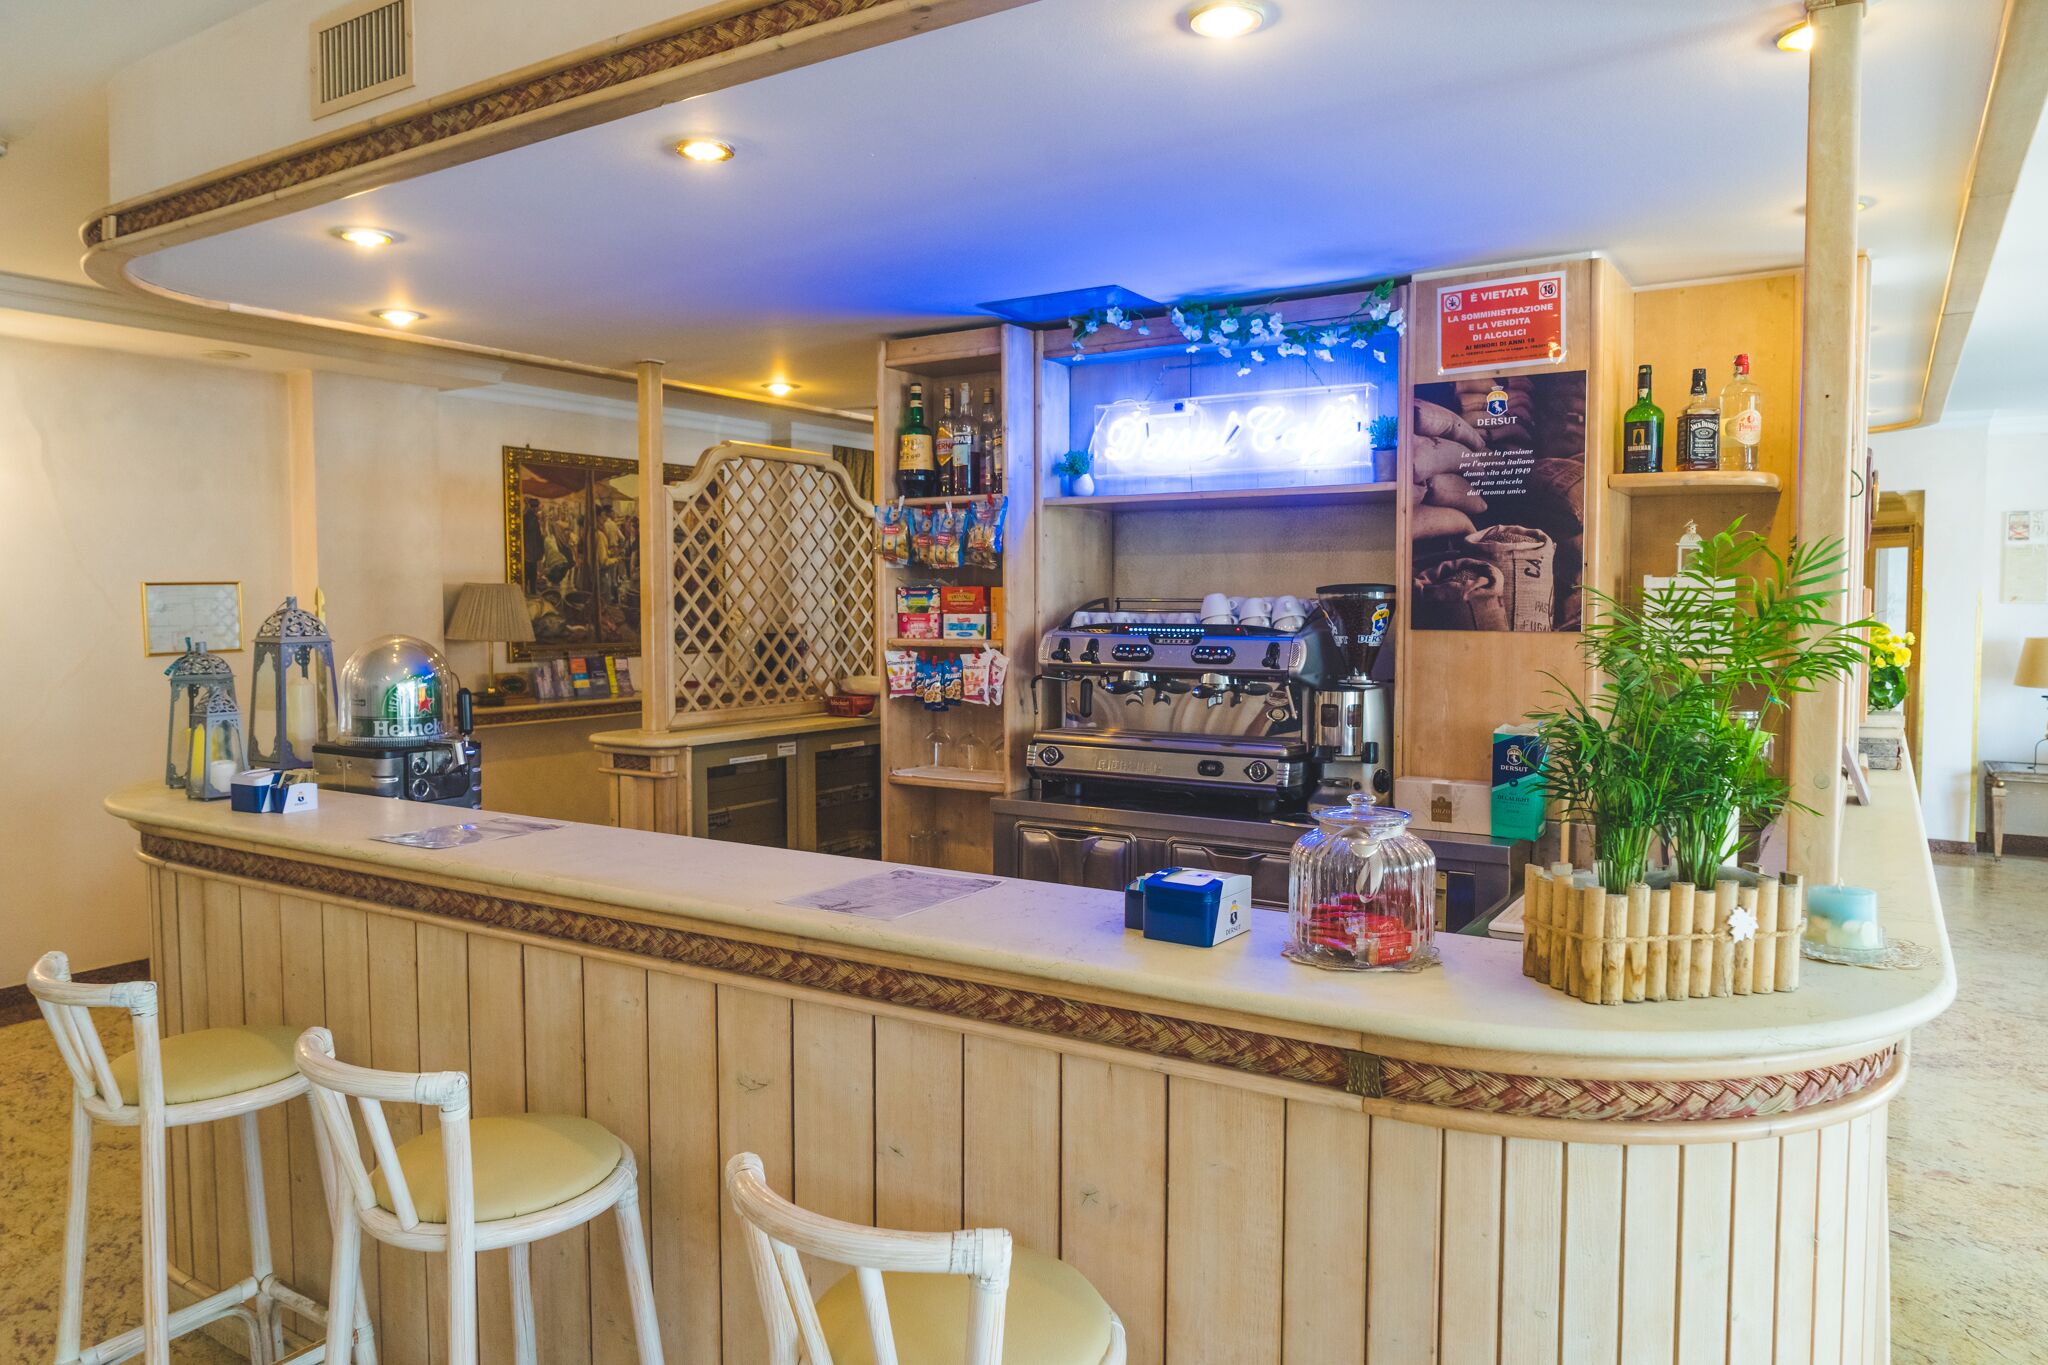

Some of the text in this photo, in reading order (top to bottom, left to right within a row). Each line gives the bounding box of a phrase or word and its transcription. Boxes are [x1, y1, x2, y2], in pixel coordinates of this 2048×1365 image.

[1470, 287, 1529, 303] È VIETATA
[1461, 303, 1553, 321] SOMMINISTRAZIONE
[1468, 317, 1531, 332] E LA VENDITA
[1472, 329, 1526, 341] DI ALCOLICI
[1474, 342, 1498, 350] MINORI
[1477, 416, 1518, 426] DERSUT
[1691, 421, 1702, 432] JACK
[1502, 448, 1533, 457] passione
[1472, 460, 1505, 468] l'espresso
[1514, 467, 1531, 475] 1949
[1500, 764, 1529, 772] DERSUT
